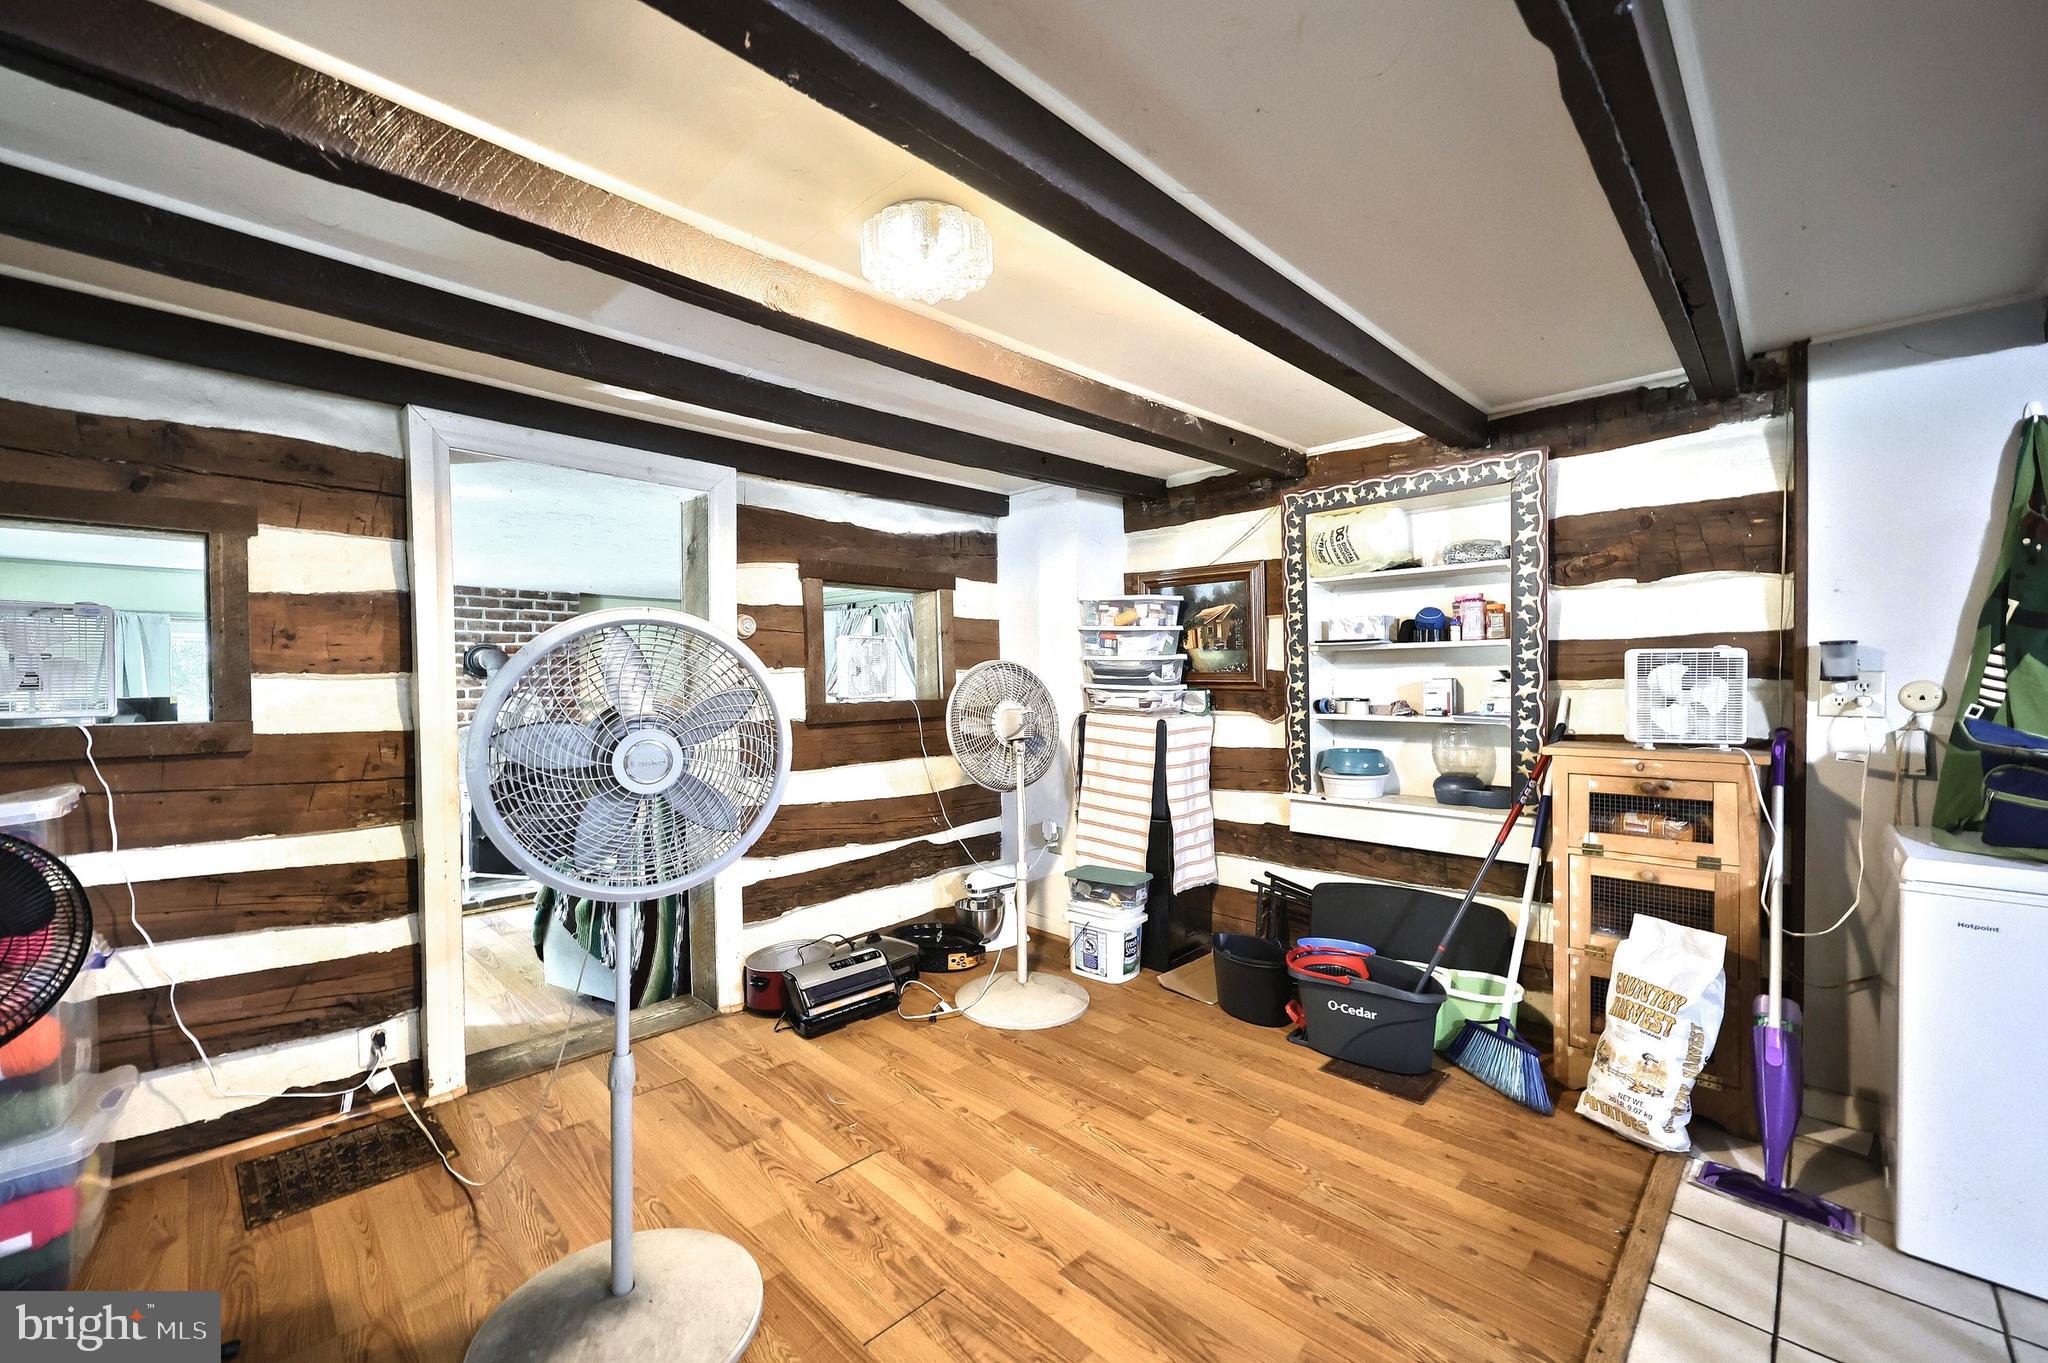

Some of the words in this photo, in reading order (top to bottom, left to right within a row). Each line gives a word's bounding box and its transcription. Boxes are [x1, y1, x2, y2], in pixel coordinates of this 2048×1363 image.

[1335, 526, 1345, 542] DG
[1957, 921, 2000, 933] Hotpoint
[1616, 972, 1687, 1014] COUNTRY
[1328, 1000, 1377, 1020] O-Cedar
[1608, 996, 1676, 1037] HARVEST
[1618, 1092, 1631, 1102] NET
[1583, 1091, 1649, 1135] POTATOES
